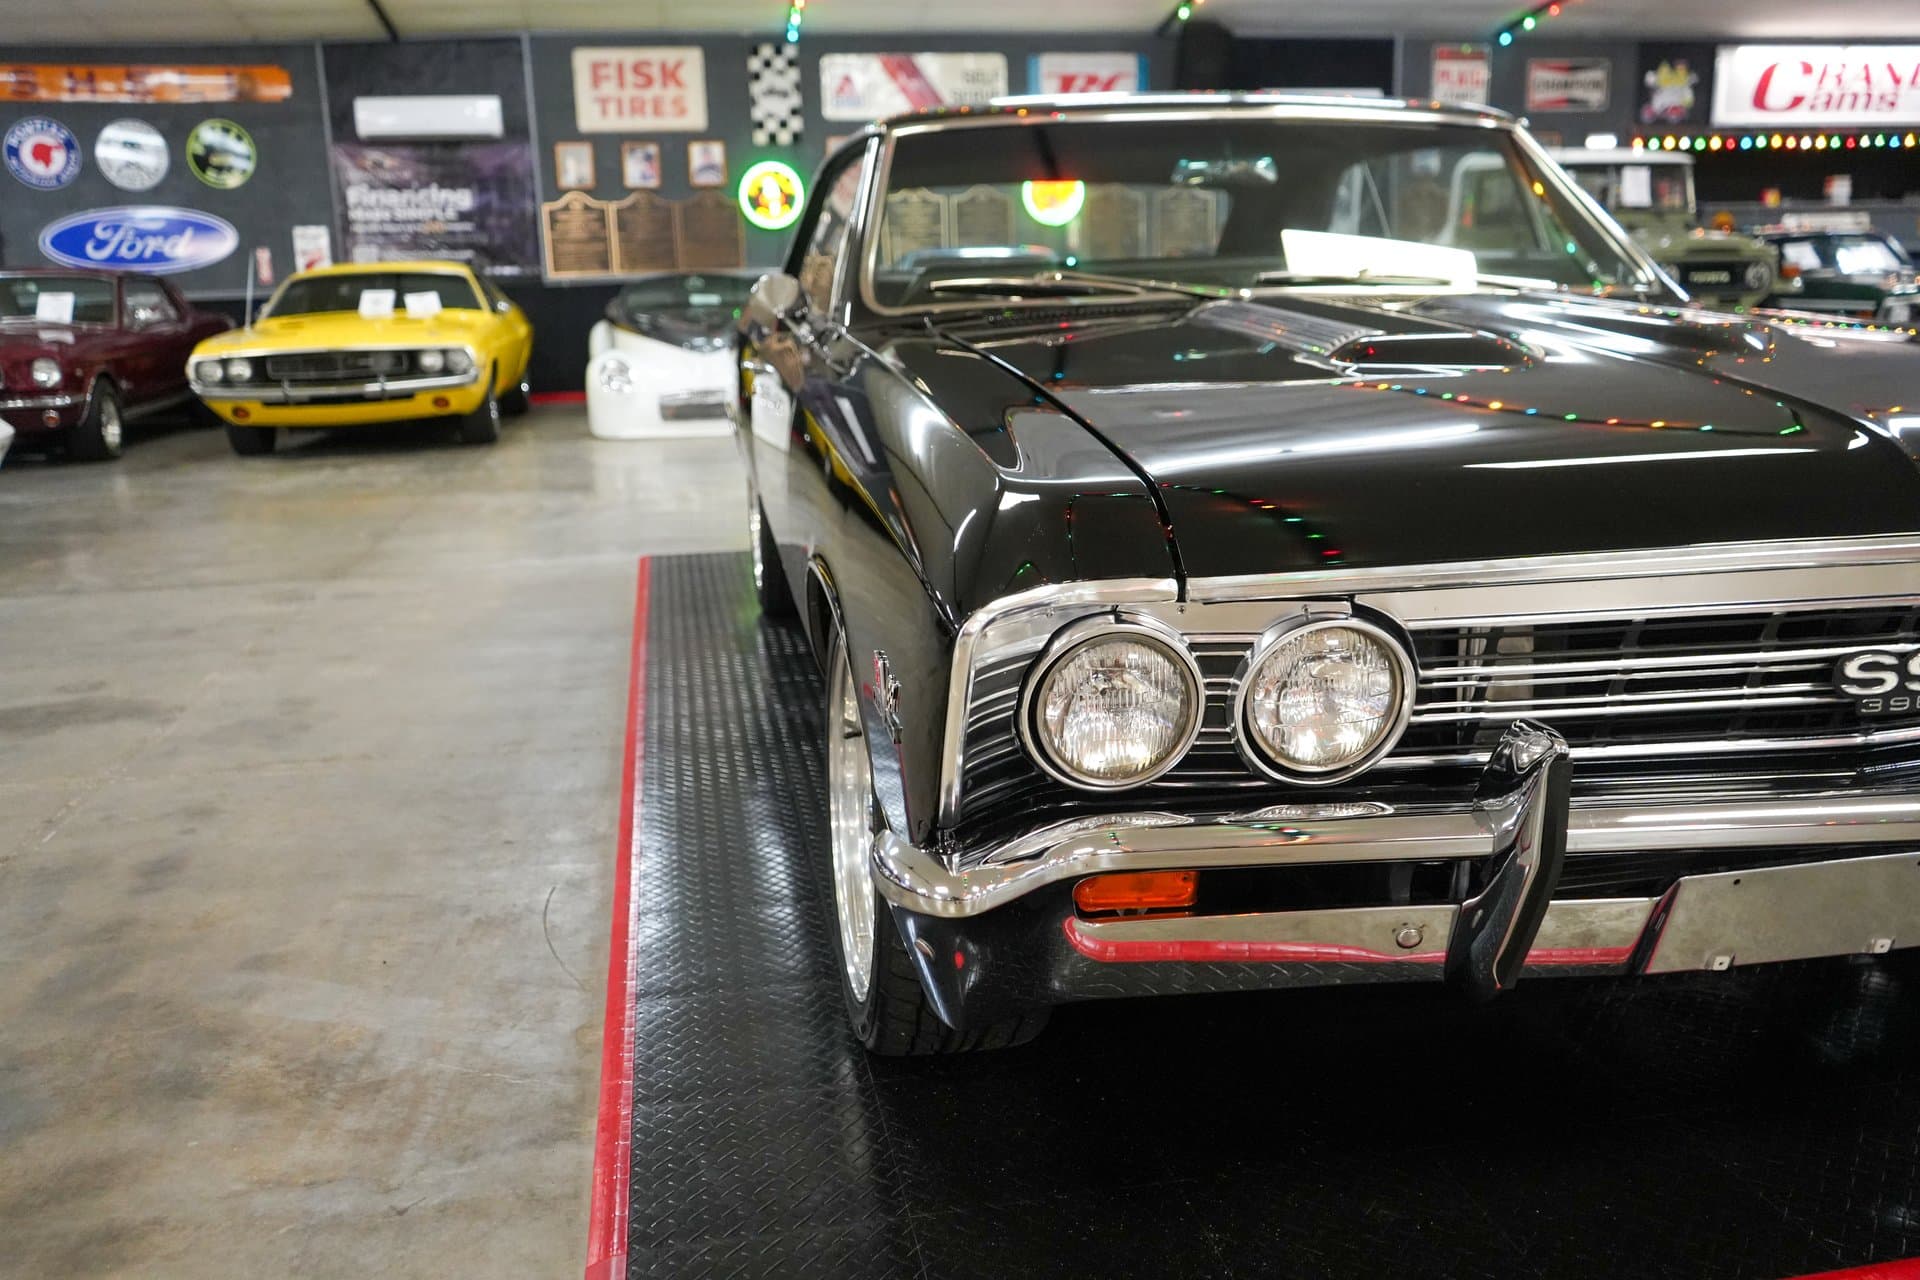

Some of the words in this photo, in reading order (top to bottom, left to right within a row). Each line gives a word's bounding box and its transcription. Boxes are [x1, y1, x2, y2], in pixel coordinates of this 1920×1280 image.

[589, 60, 685, 89] FISK
[594, 95, 689, 118] TIRES
[85, 217, 196, 261] Ford
[1860, 696, 1920, 713] 39
